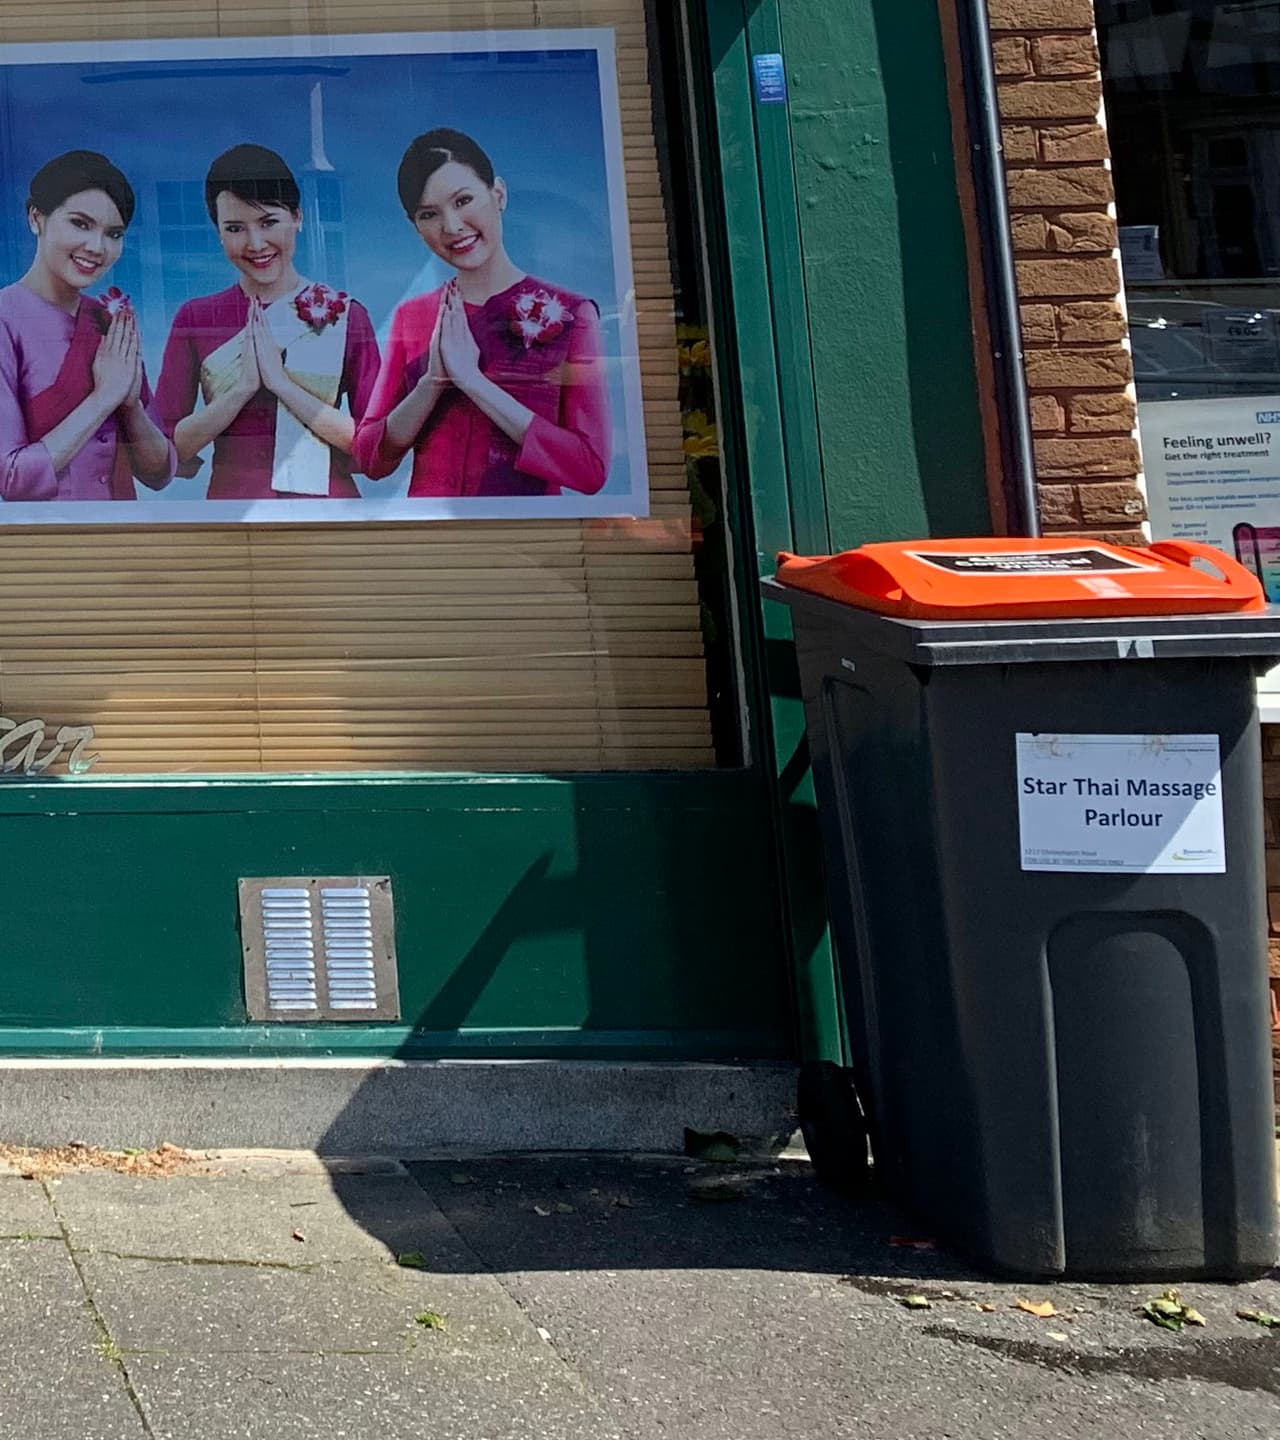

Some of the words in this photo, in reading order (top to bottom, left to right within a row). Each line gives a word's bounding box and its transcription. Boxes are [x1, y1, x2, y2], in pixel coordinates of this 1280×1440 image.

[1163, 435, 1214, 449] Feeling
[1217, 431, 1272, 446] unwell?
[1164, 452, 1182, 461] Get
[1183, 452, 1198, 460] the
[1200, 450, 1222, 460] right
[1223, 449, 1270, 459] treatment
[1023, 777, 1068, 796] Star
[1073, 778, 1120, 796] Thai
[1127, 778, 1217, 800] Massage
[1085, 808, 1163, 827] Parlour
